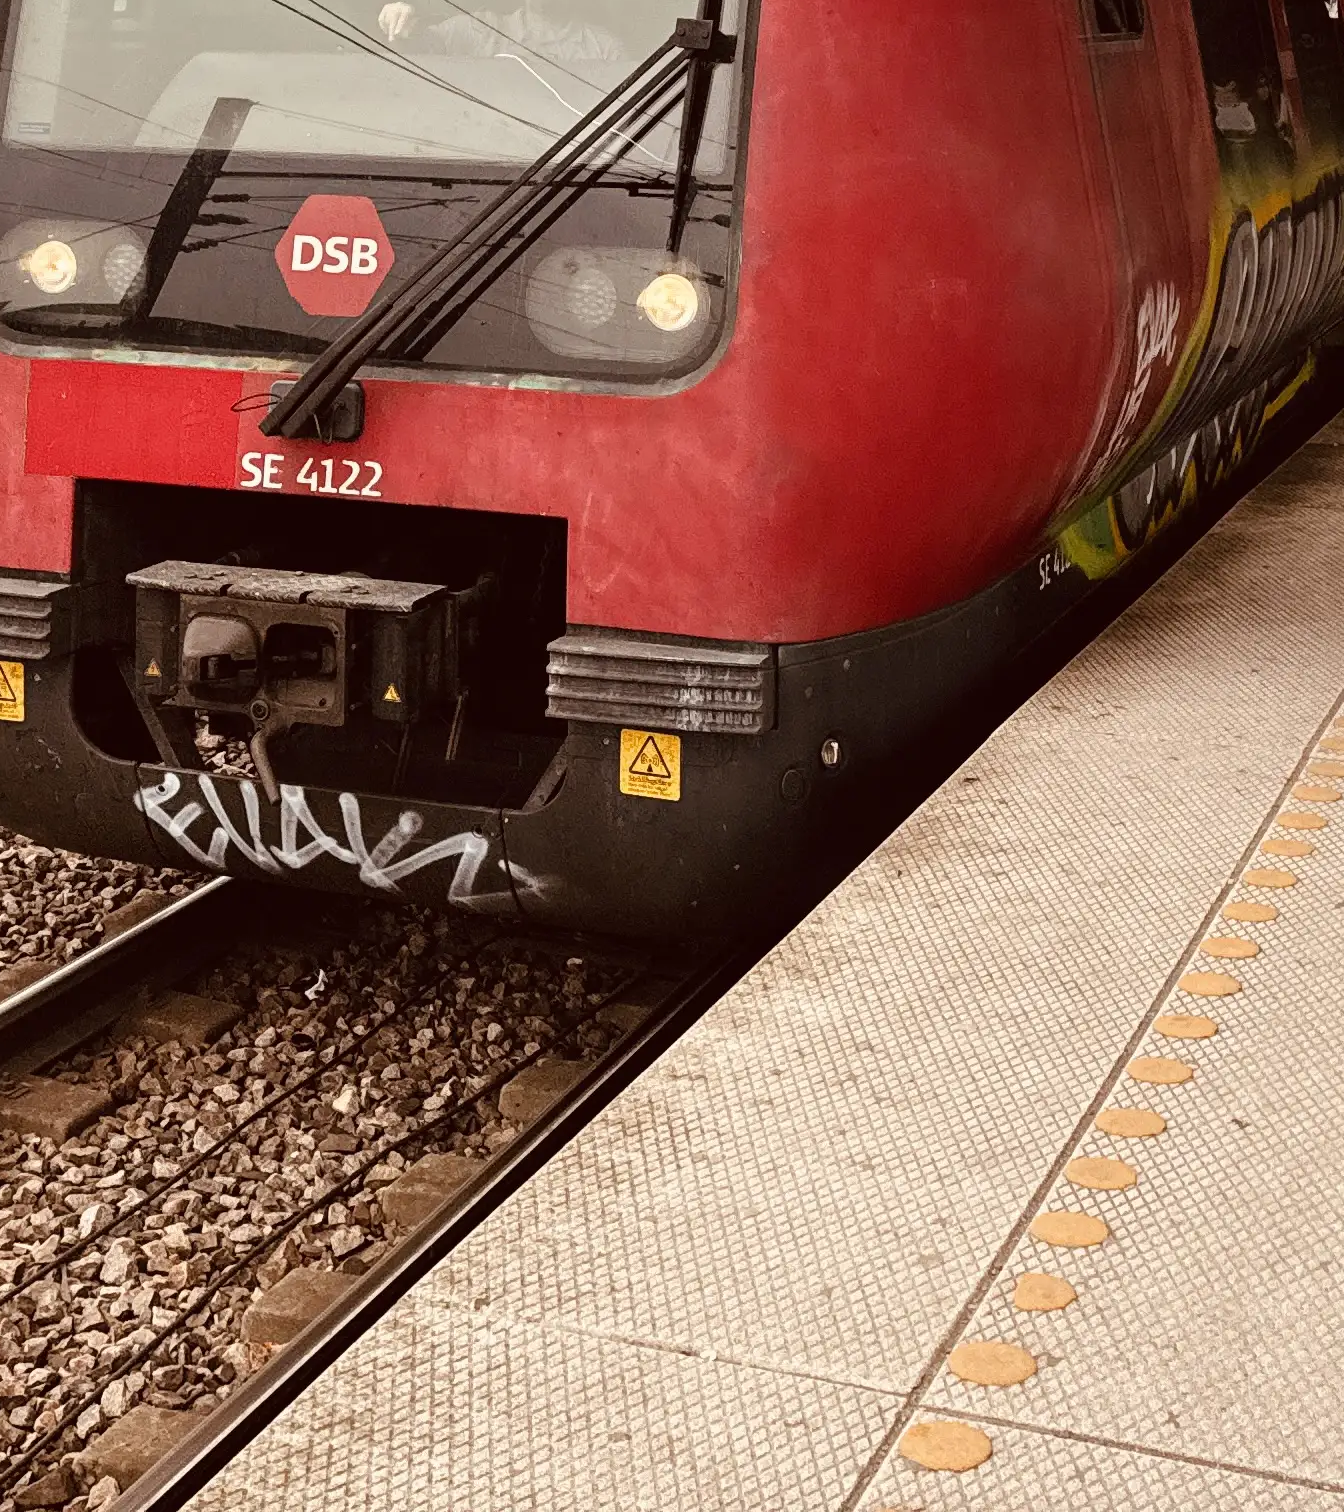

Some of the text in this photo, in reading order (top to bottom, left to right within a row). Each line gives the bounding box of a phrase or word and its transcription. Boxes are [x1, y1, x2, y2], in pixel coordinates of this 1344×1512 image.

[291, 234, 378, 275] DSB
[240, 451, 383, 497] SE 4122
[1039, 553, 1051, 591] SE
